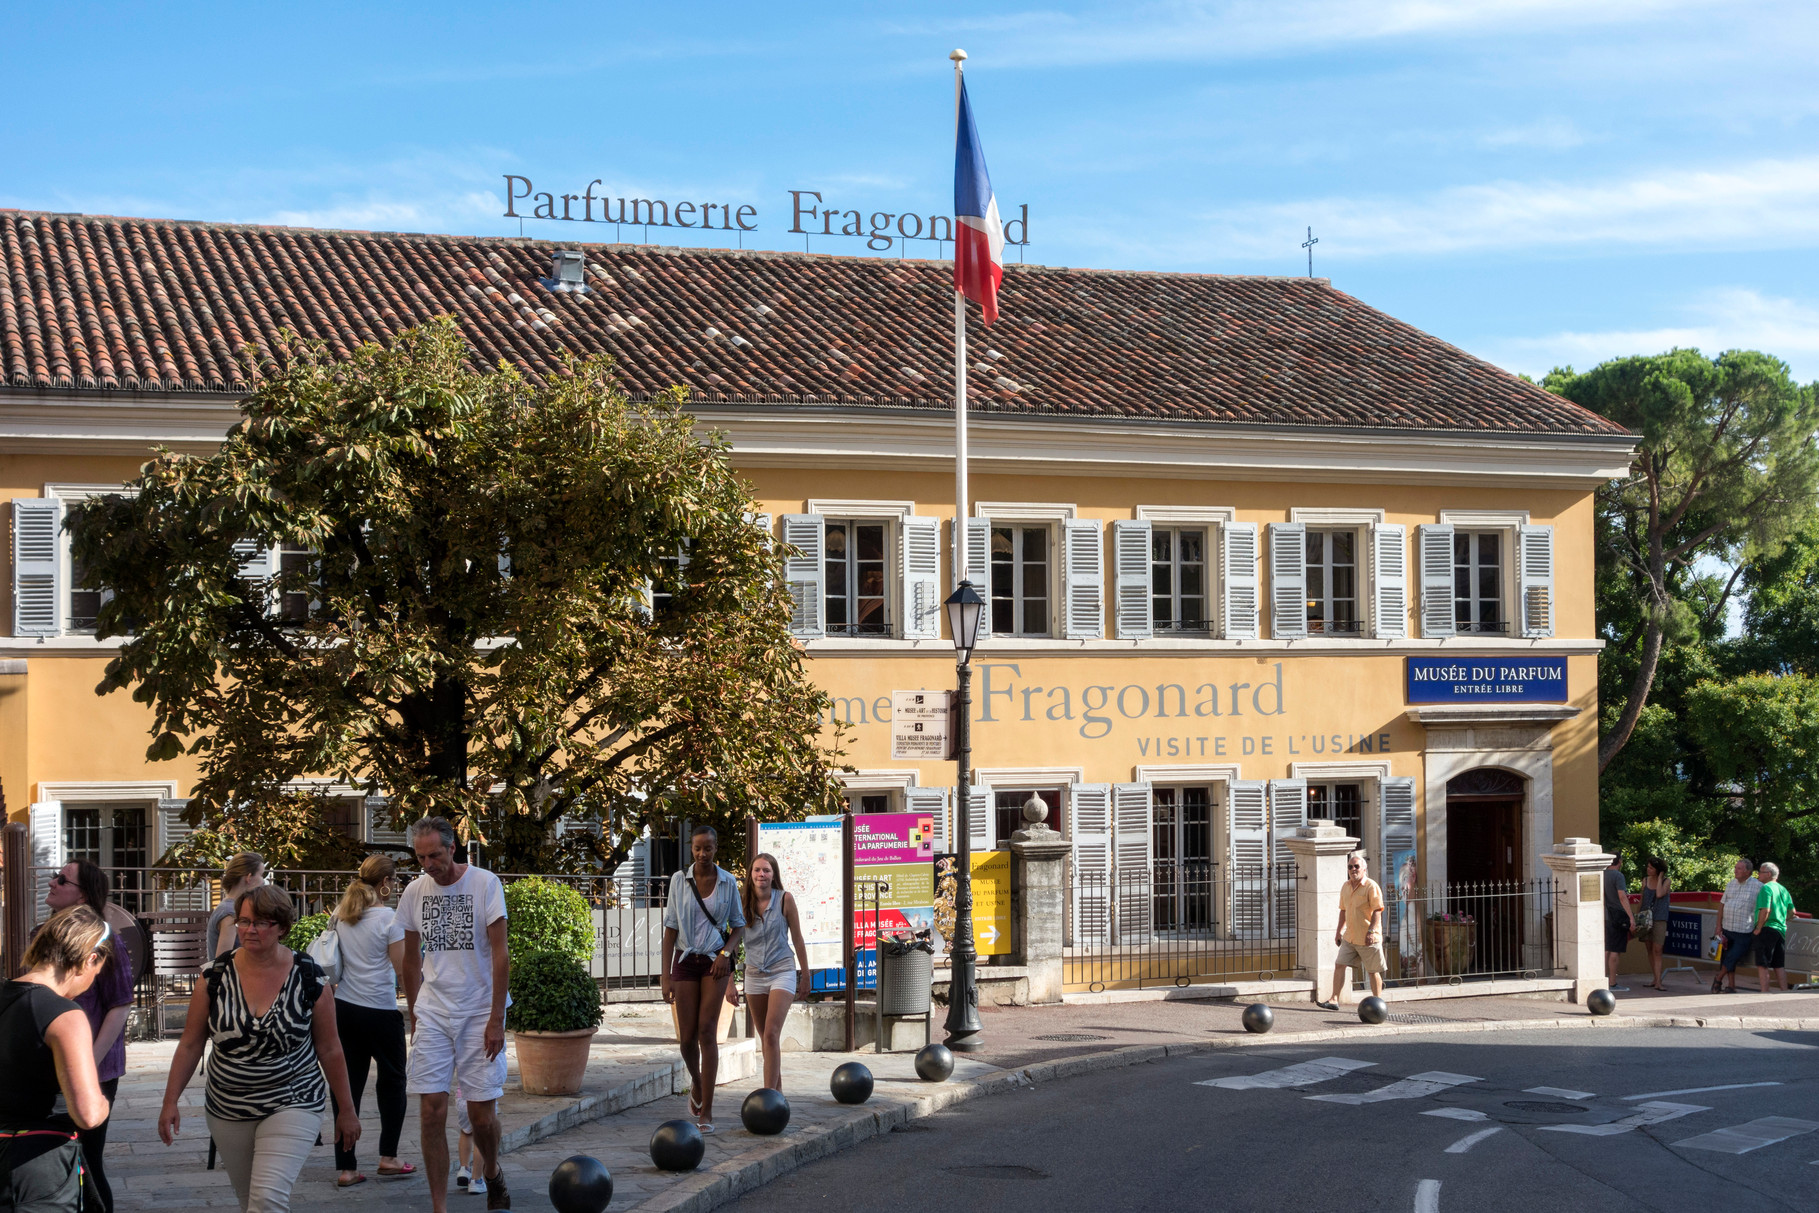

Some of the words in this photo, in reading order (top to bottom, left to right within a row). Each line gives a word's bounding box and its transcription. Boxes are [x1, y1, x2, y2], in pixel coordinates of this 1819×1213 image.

[502, 174, 758, 230] Parfumerie
[788, 190, 1030, 250] Fragond
[1414, 664, 1468, 681] MUSÉE
[1472, 667, 1495, 681] DU
[1500, 666, 1562, 681] PARFUM
[1454, 684, 1493, 694] ENTRÉE
[1496, 685, 1524, 693] LIBRE
[975, 662, 1287, 739] Fragonard
[1137, 737, 1227, 757] VISITE
[1242, 736, 1273, 755] DE
[1289, 733, 1391, 755] L'USINE
[854, 824, 870, 833] USÉE
[854, 833, 898, 842] TERNATIONAL
[867, 841, 908, 849] PARFUMERIE
[972, 862, 1009, 871] Fragonard
[859, 891, 893, 900] PROVNCE
[854, 921, 869, 929] ILLA
[1672, 920, 1699, 930] VISITE
